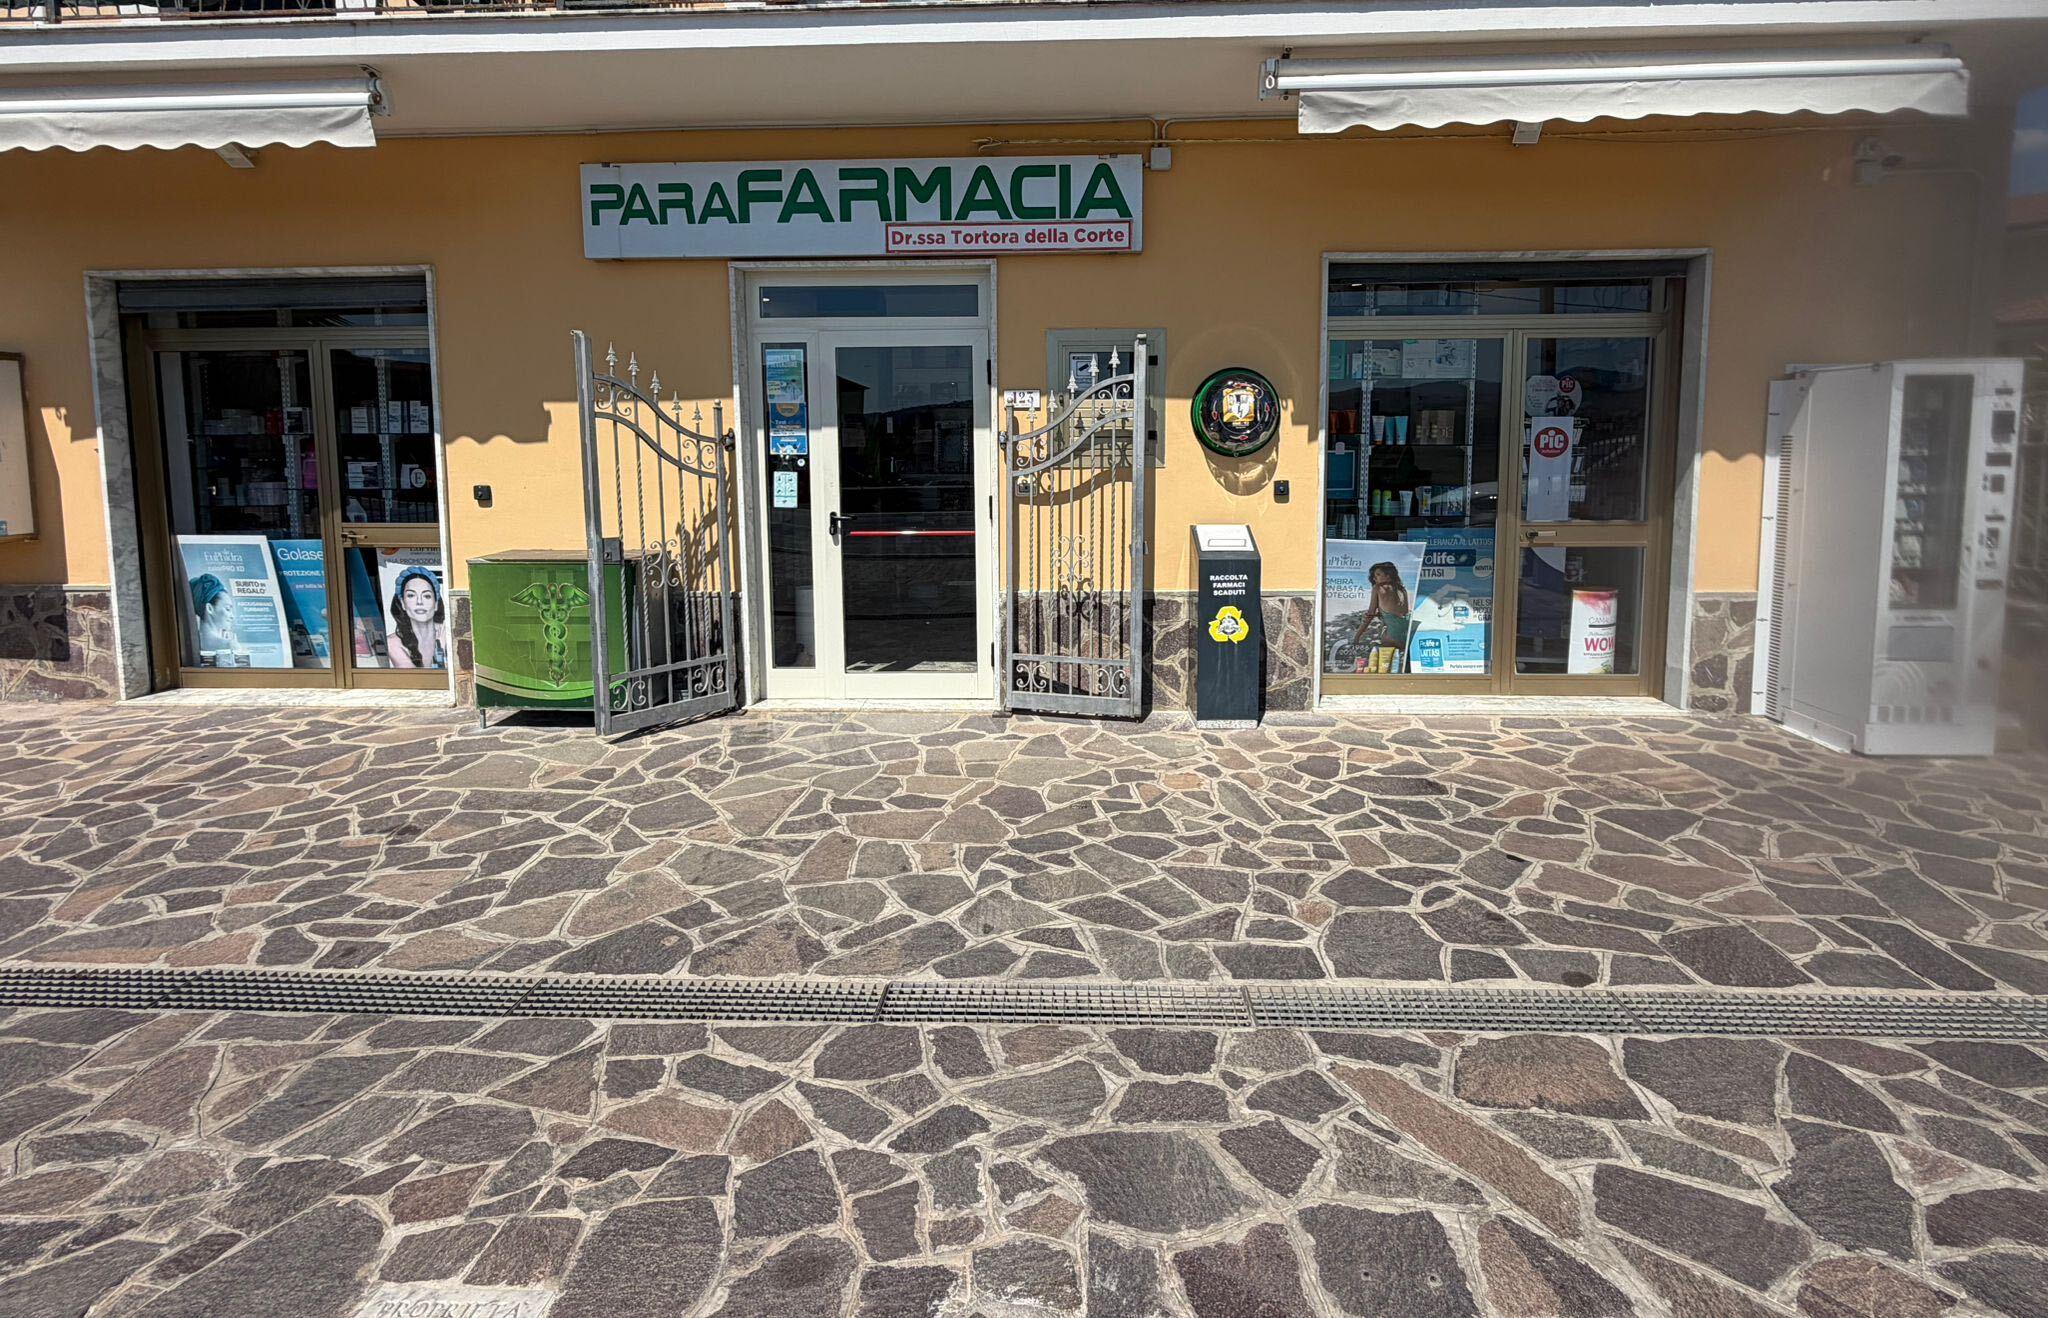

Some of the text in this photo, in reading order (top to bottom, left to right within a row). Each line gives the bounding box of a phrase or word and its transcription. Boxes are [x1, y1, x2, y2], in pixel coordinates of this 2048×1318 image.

[590, 163, 1133, 226] PARAFARMACIA
[891, 227, 1125, 246] Dr.ssa Tortora della Corte
[1539, 430, 1565, 449] PiC
